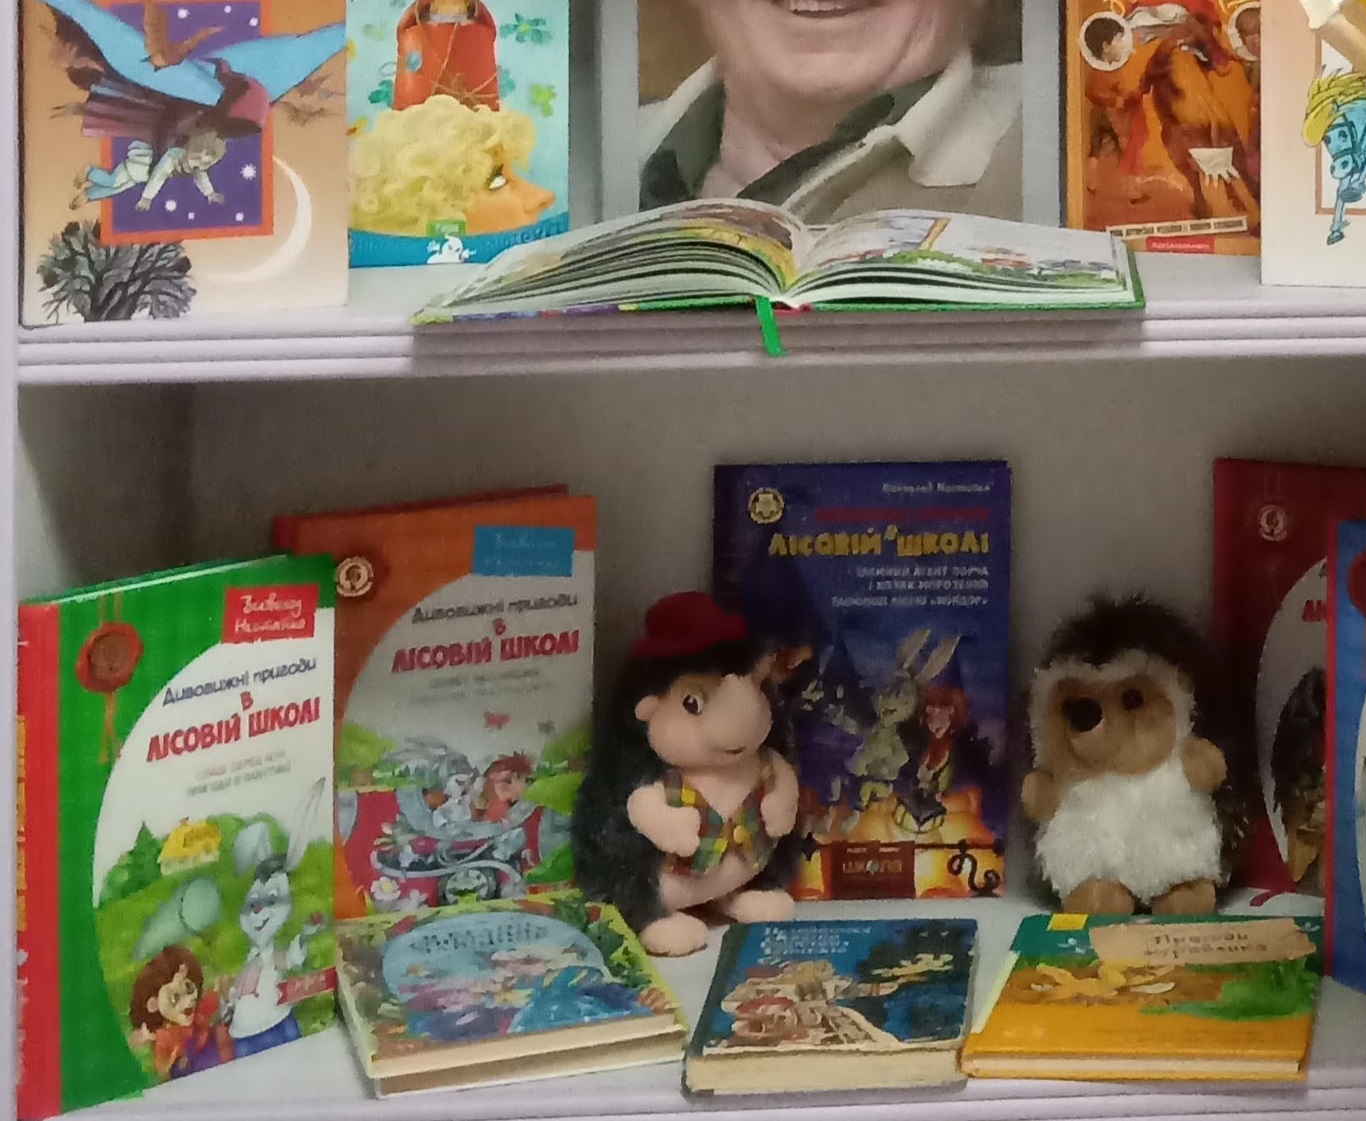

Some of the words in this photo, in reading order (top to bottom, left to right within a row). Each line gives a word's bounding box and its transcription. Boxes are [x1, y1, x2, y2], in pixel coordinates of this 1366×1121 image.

[896, 531, 990, 557] ШКОЛІ
[391, 636, 493, 674] ЛІСОВІЙ
[500, 629, 581, 661] ШКОЛІ
[162, 669, 250, 707] Дивовижні
[252, 657, 318, 685] пригоди
[239, 691, 254, 711] В
[146, 712, 242, 763] ЛІСОВІЙ
[248, 696, 322, 738] ШКОЛІ
